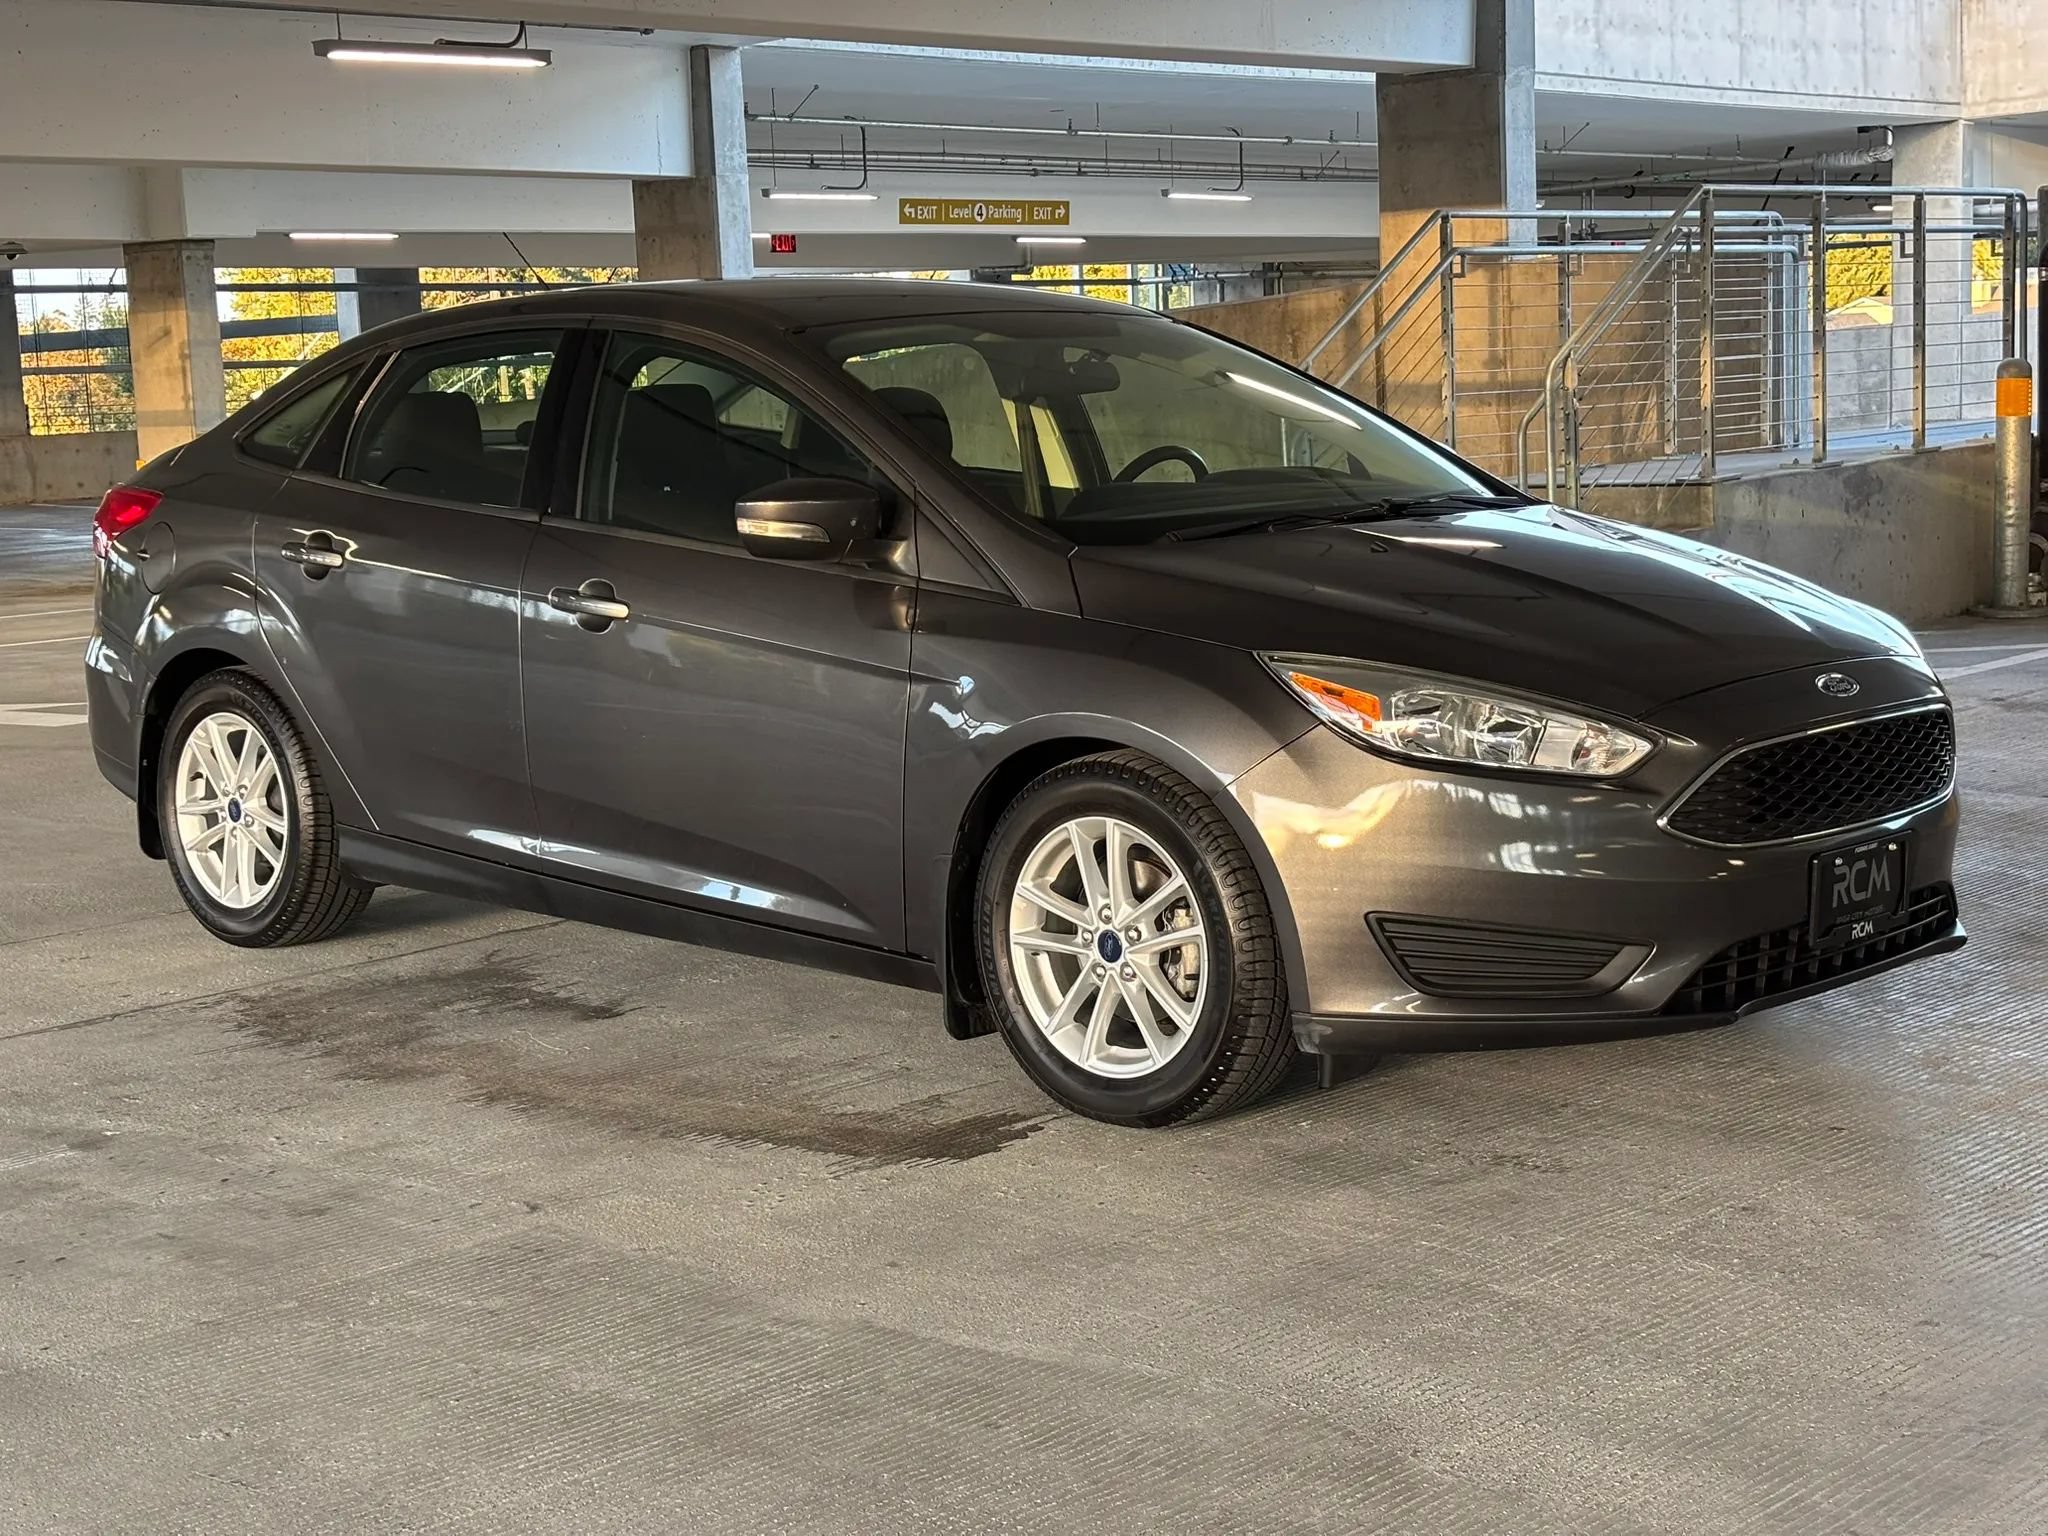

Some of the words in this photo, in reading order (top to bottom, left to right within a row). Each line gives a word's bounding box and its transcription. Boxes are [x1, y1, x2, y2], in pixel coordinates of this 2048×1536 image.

[917, 205, 938, 220] EXIT
[950, 204, 972, 219] Level
[976, 204, 985, 220] 4
[988, 203, 1022, 223] Parking
[1033, 206, 1052, 220] EXIT
[1832, 855, 1891, 909] RCM
[1851, 920, 1874, 940] RCM
[981, 899, 1001, 997] MICHELIN
